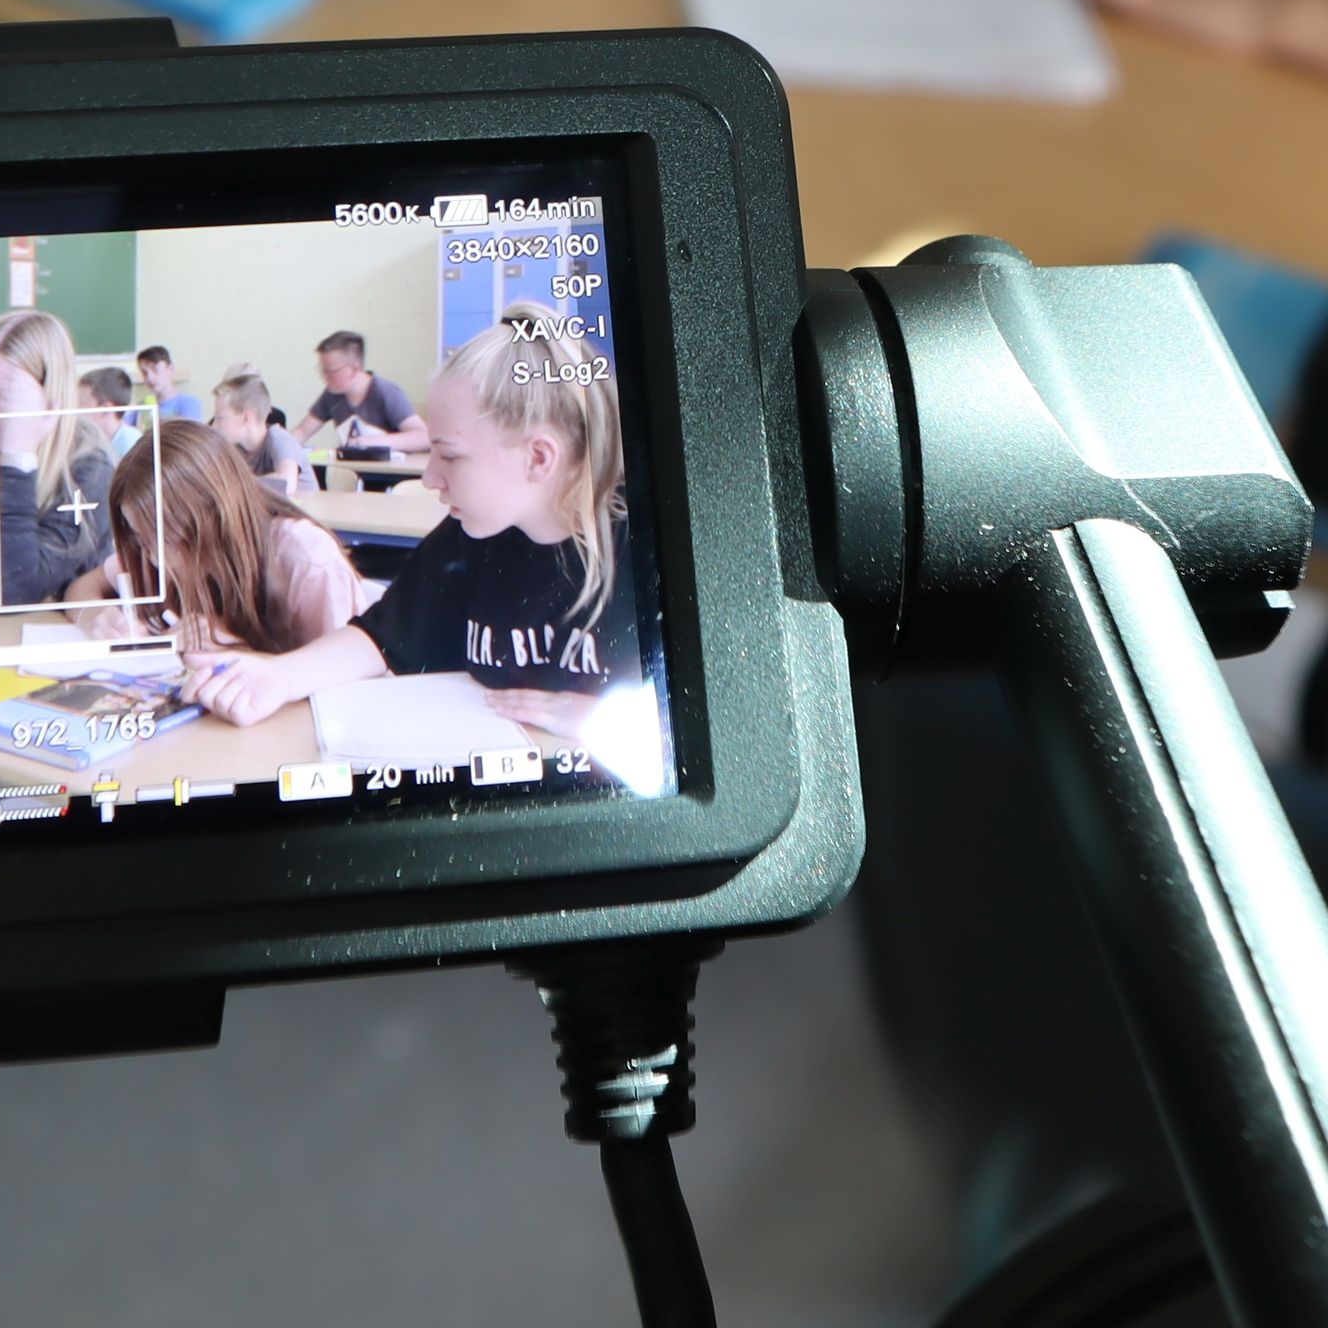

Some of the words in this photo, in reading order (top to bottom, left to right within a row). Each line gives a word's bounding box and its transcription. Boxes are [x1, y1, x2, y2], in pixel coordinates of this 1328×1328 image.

[335, 201, 420, 228] 5600K
[494, 199, 542, 223] 164
[546, 195, 596, 220] min
[551, 273, 603, 300] 50P
[511, 314, 607, 344] XAVC-I
[513, 356, 610, 386] S-Log2
[555, 747, 591, 774] 32
[366, 763, 402, 790] 20
[415, 762, 455, 785] min
